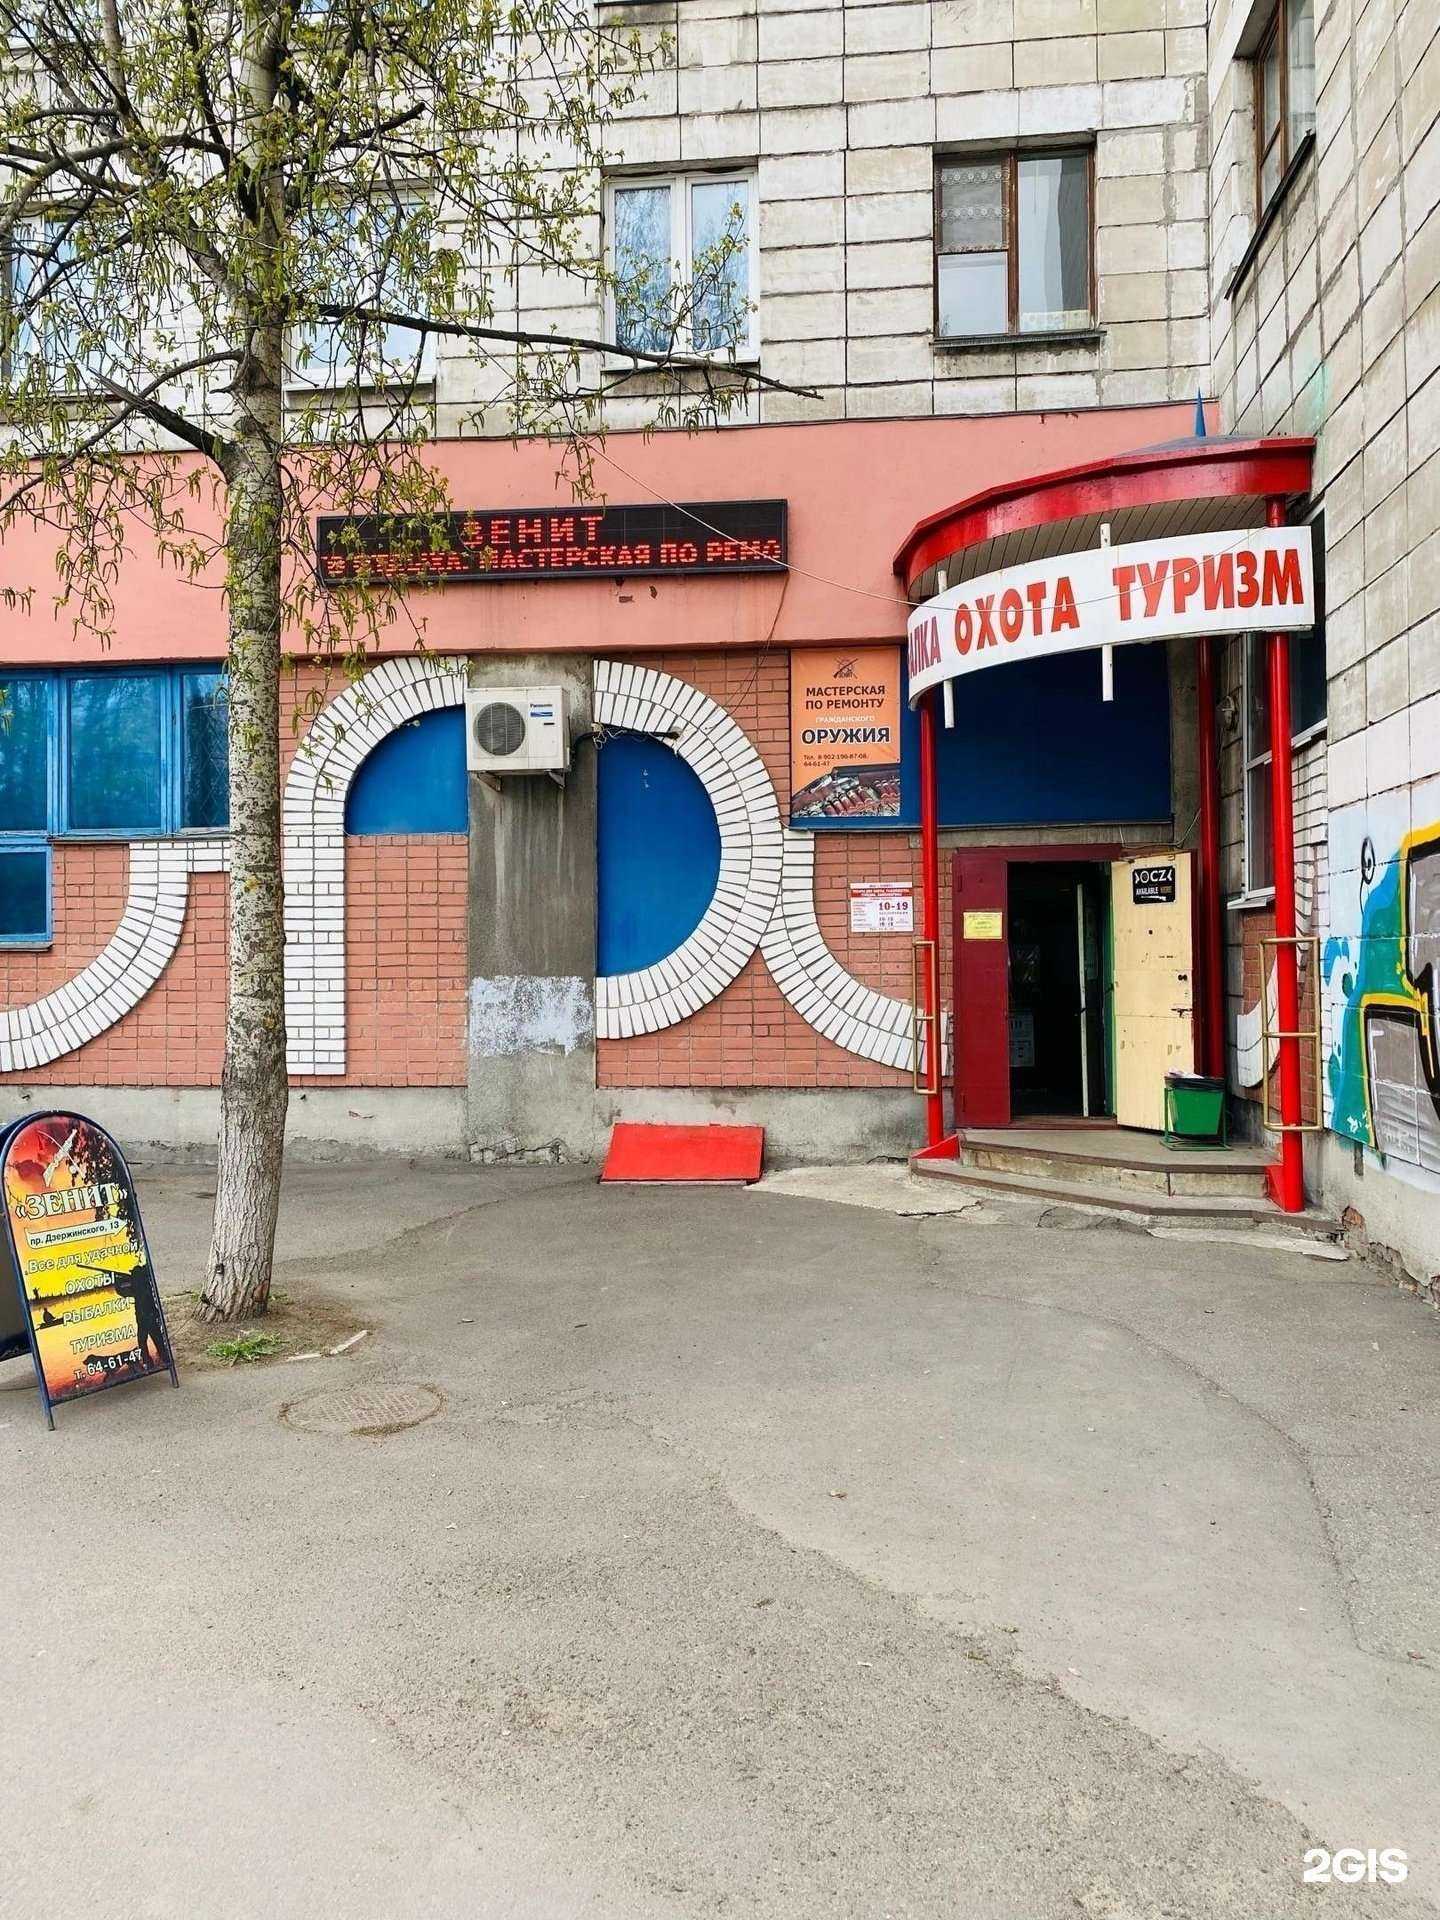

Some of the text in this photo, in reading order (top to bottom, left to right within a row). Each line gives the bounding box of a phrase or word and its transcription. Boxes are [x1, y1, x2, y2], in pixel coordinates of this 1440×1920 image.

[463, 516, 603, 546] ЗЕНИТ
[479, 544, 650, 569] МАСТЕРСКАЯ
[660, 543, 698, 564] ПО
[954, 576, 1081, 656] ОХОТА
[1112, 548, 1305, 622] ТУРИЗМ
[805, 698, 885, 710] ПО РЕМОНТУ
[806, 685, 885, 697] МАСТЕРСКАЯ
[801, 727, 890, 745] ОРУЖИЯ
[878, 901, 909, 911] 10-19
[15, 1182, 128, 1220] «ЗЕНИТ»
[30, 1220, 120, 1247] пр. Дзержинского, 13
[28, 1239, 139, 1274] Все для удачной
[65, 1271, 115, 1295] ОХОТЫ
[63, 1297, 132, 1326] РЫБАЛКИ
[70, 1324, 137, 1355] ТУРИЗМА
[86, 1348, 143, 1376] 64-61-47
